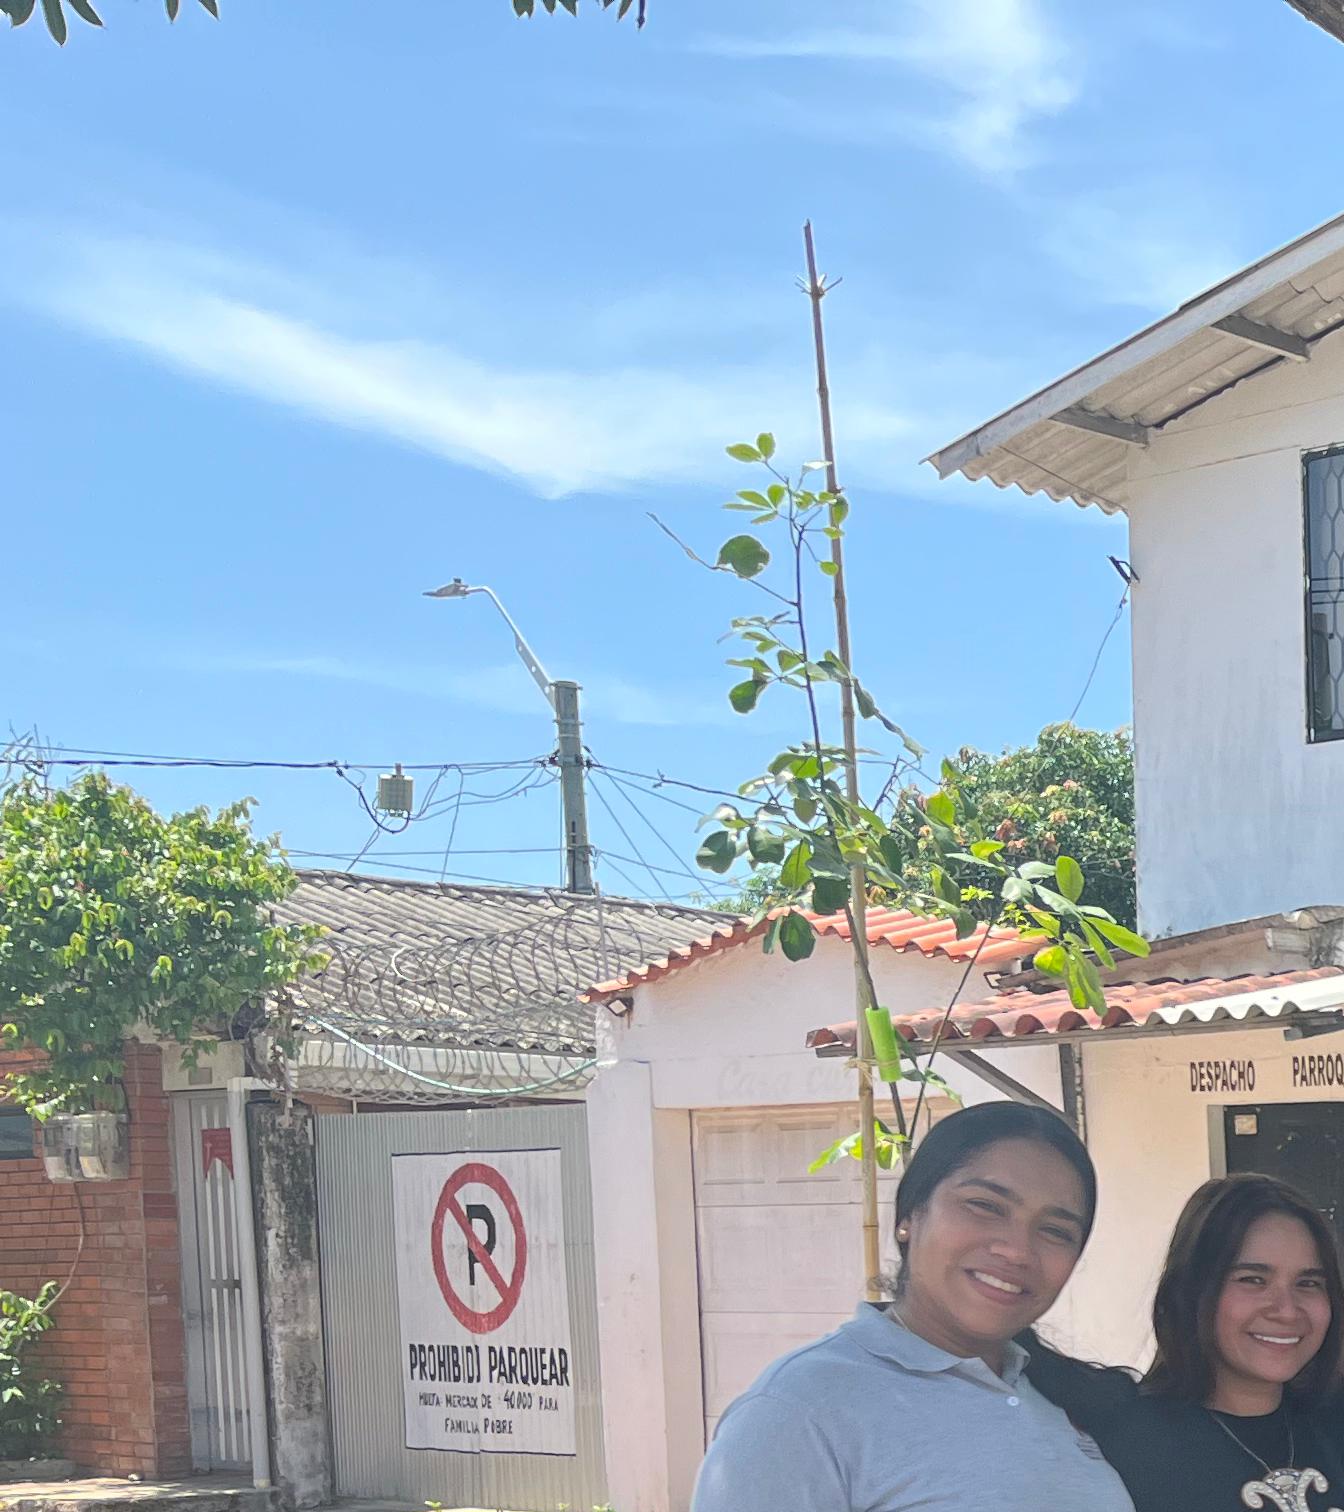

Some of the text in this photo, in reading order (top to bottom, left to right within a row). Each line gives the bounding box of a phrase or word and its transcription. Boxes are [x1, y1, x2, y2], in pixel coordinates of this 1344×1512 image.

[1190, 1060, 1256, 1092] DESPACHO
[489, 1346, 570, 1387] PARQUEAR
[481, 1393, 493, 1410] DE
[538, 1395, 559, 1411] PARA
[444, 1417, 513, 1435] FAMILIA POBRE
